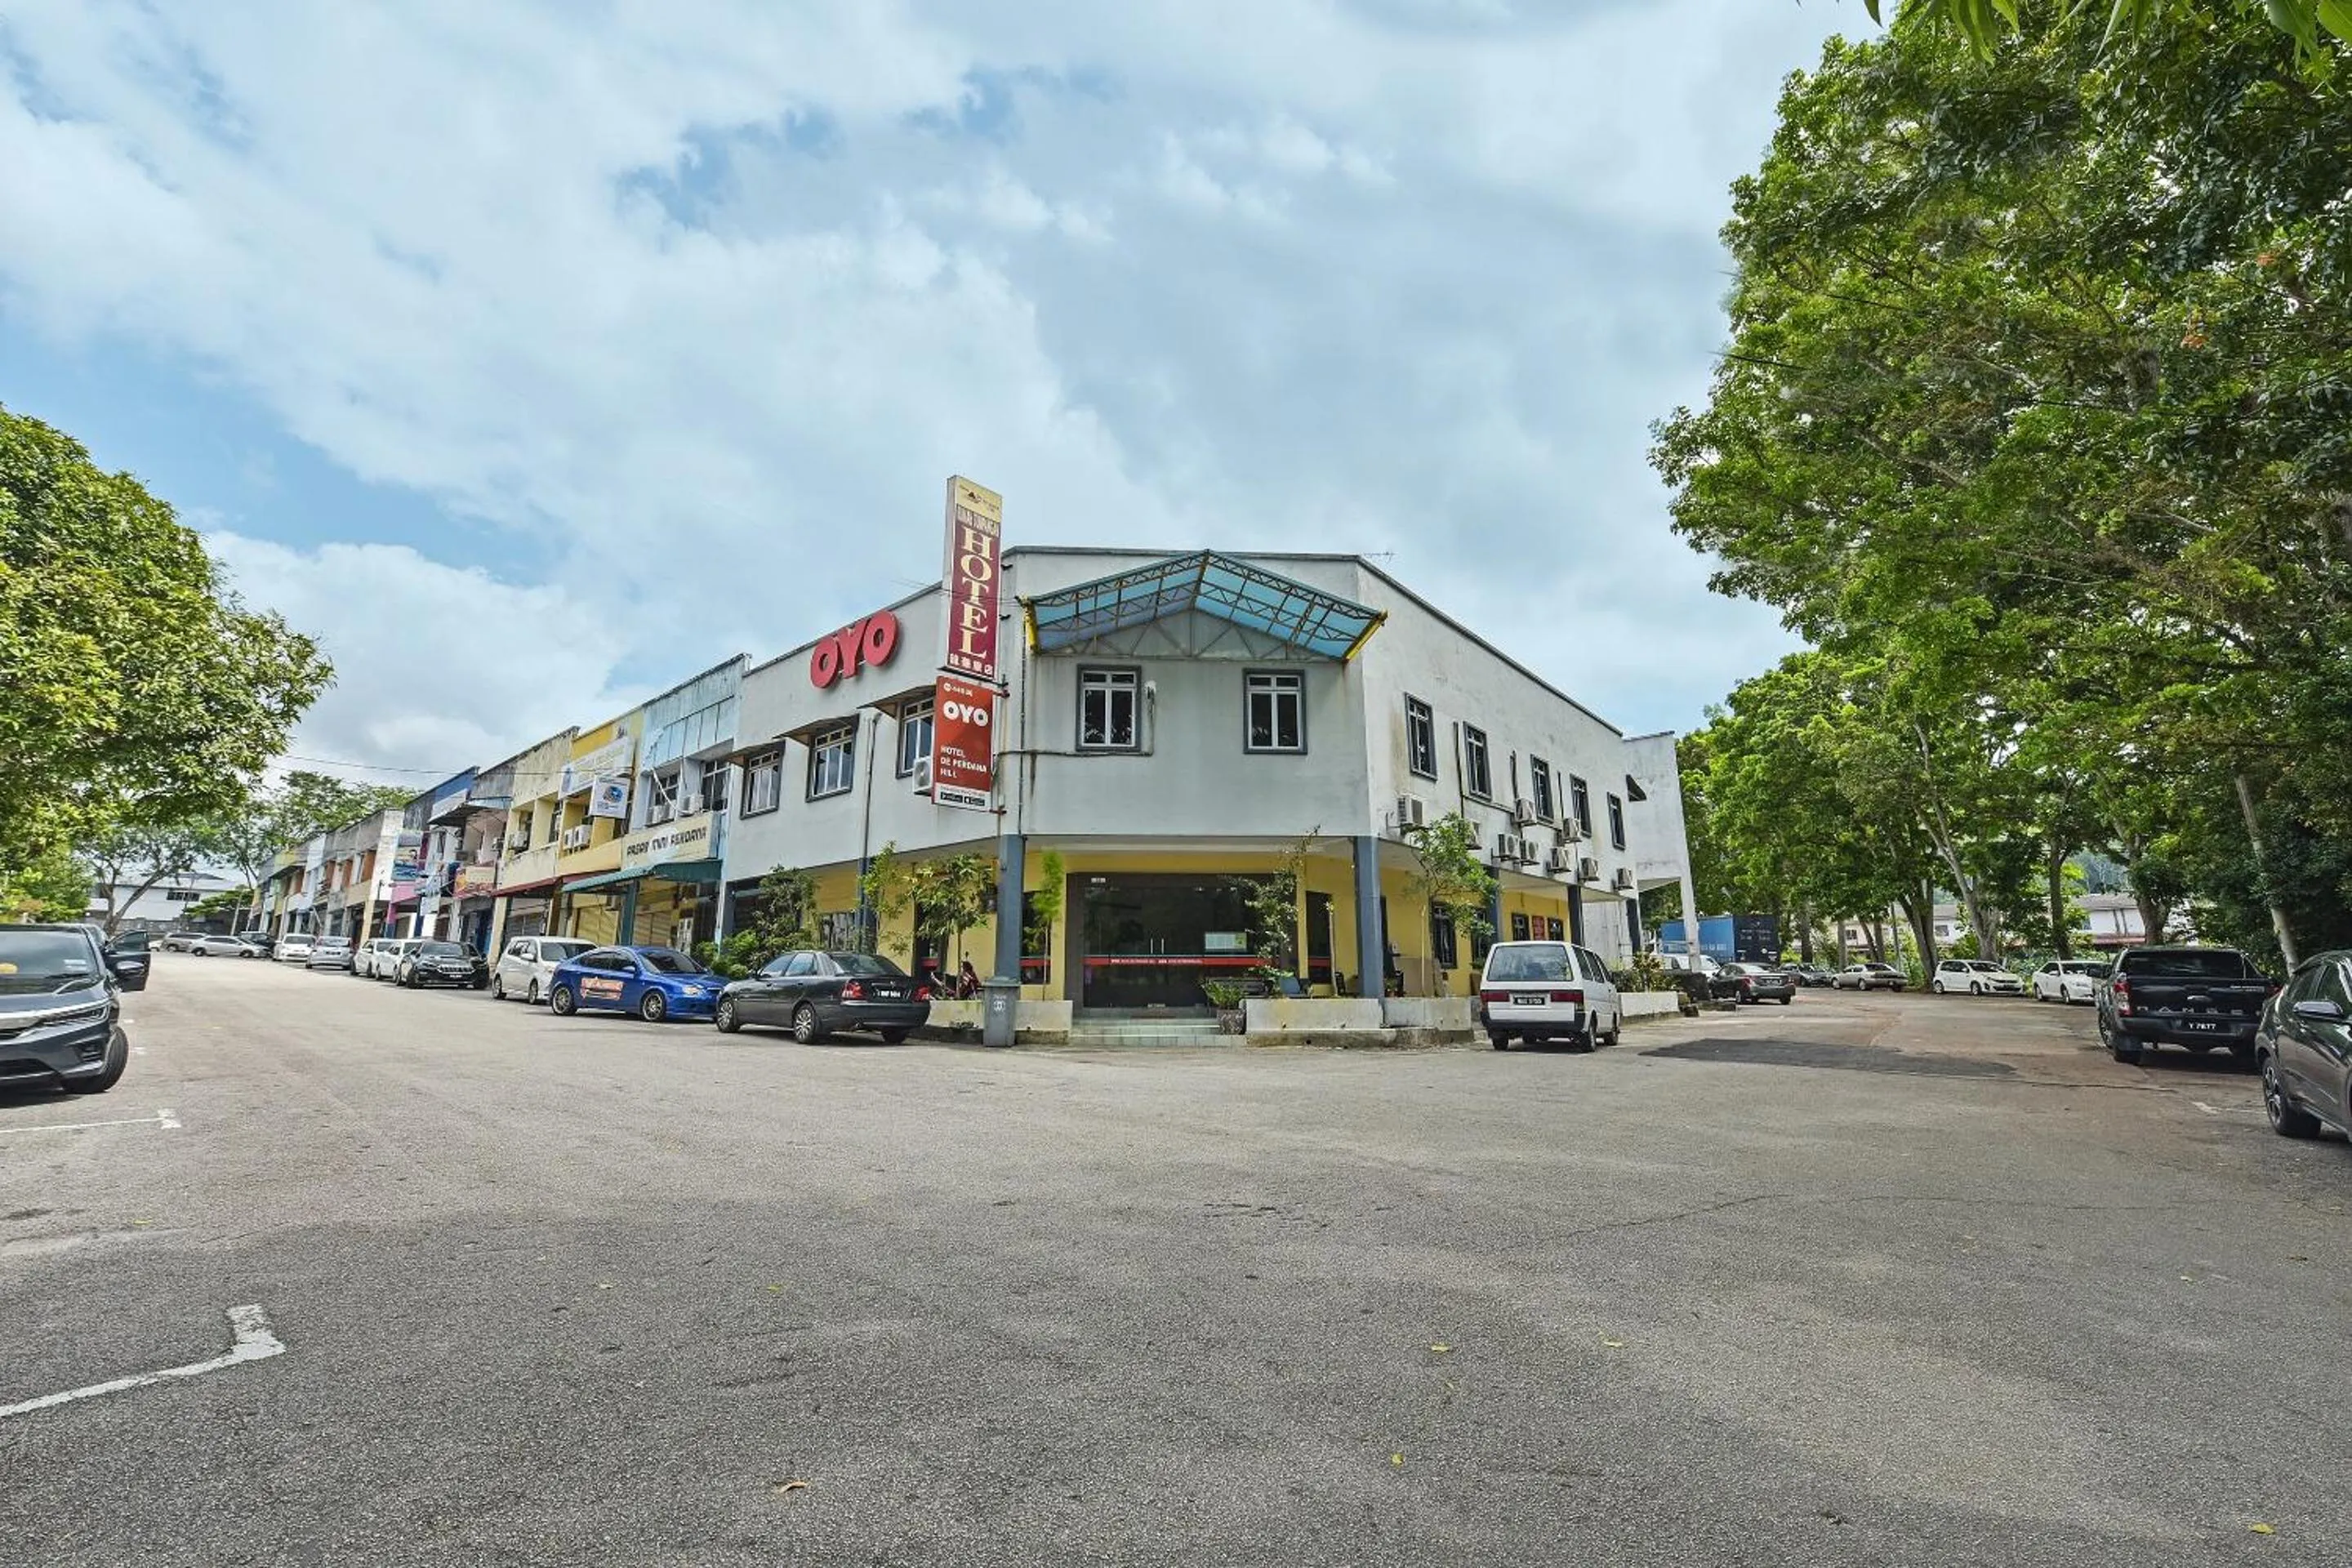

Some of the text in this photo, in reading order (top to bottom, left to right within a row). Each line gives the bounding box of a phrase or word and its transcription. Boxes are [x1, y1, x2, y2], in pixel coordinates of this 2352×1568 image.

[959, 525, 994, 659] HOTEL
[810, 610, 899, 689] OYO
[943, 700, 988, 727] OYO
[940, 745, 965, 758] HOTEL
[940, 756, 987, 773] DE PERDANA
[940, 768, 957, 778] HILL
